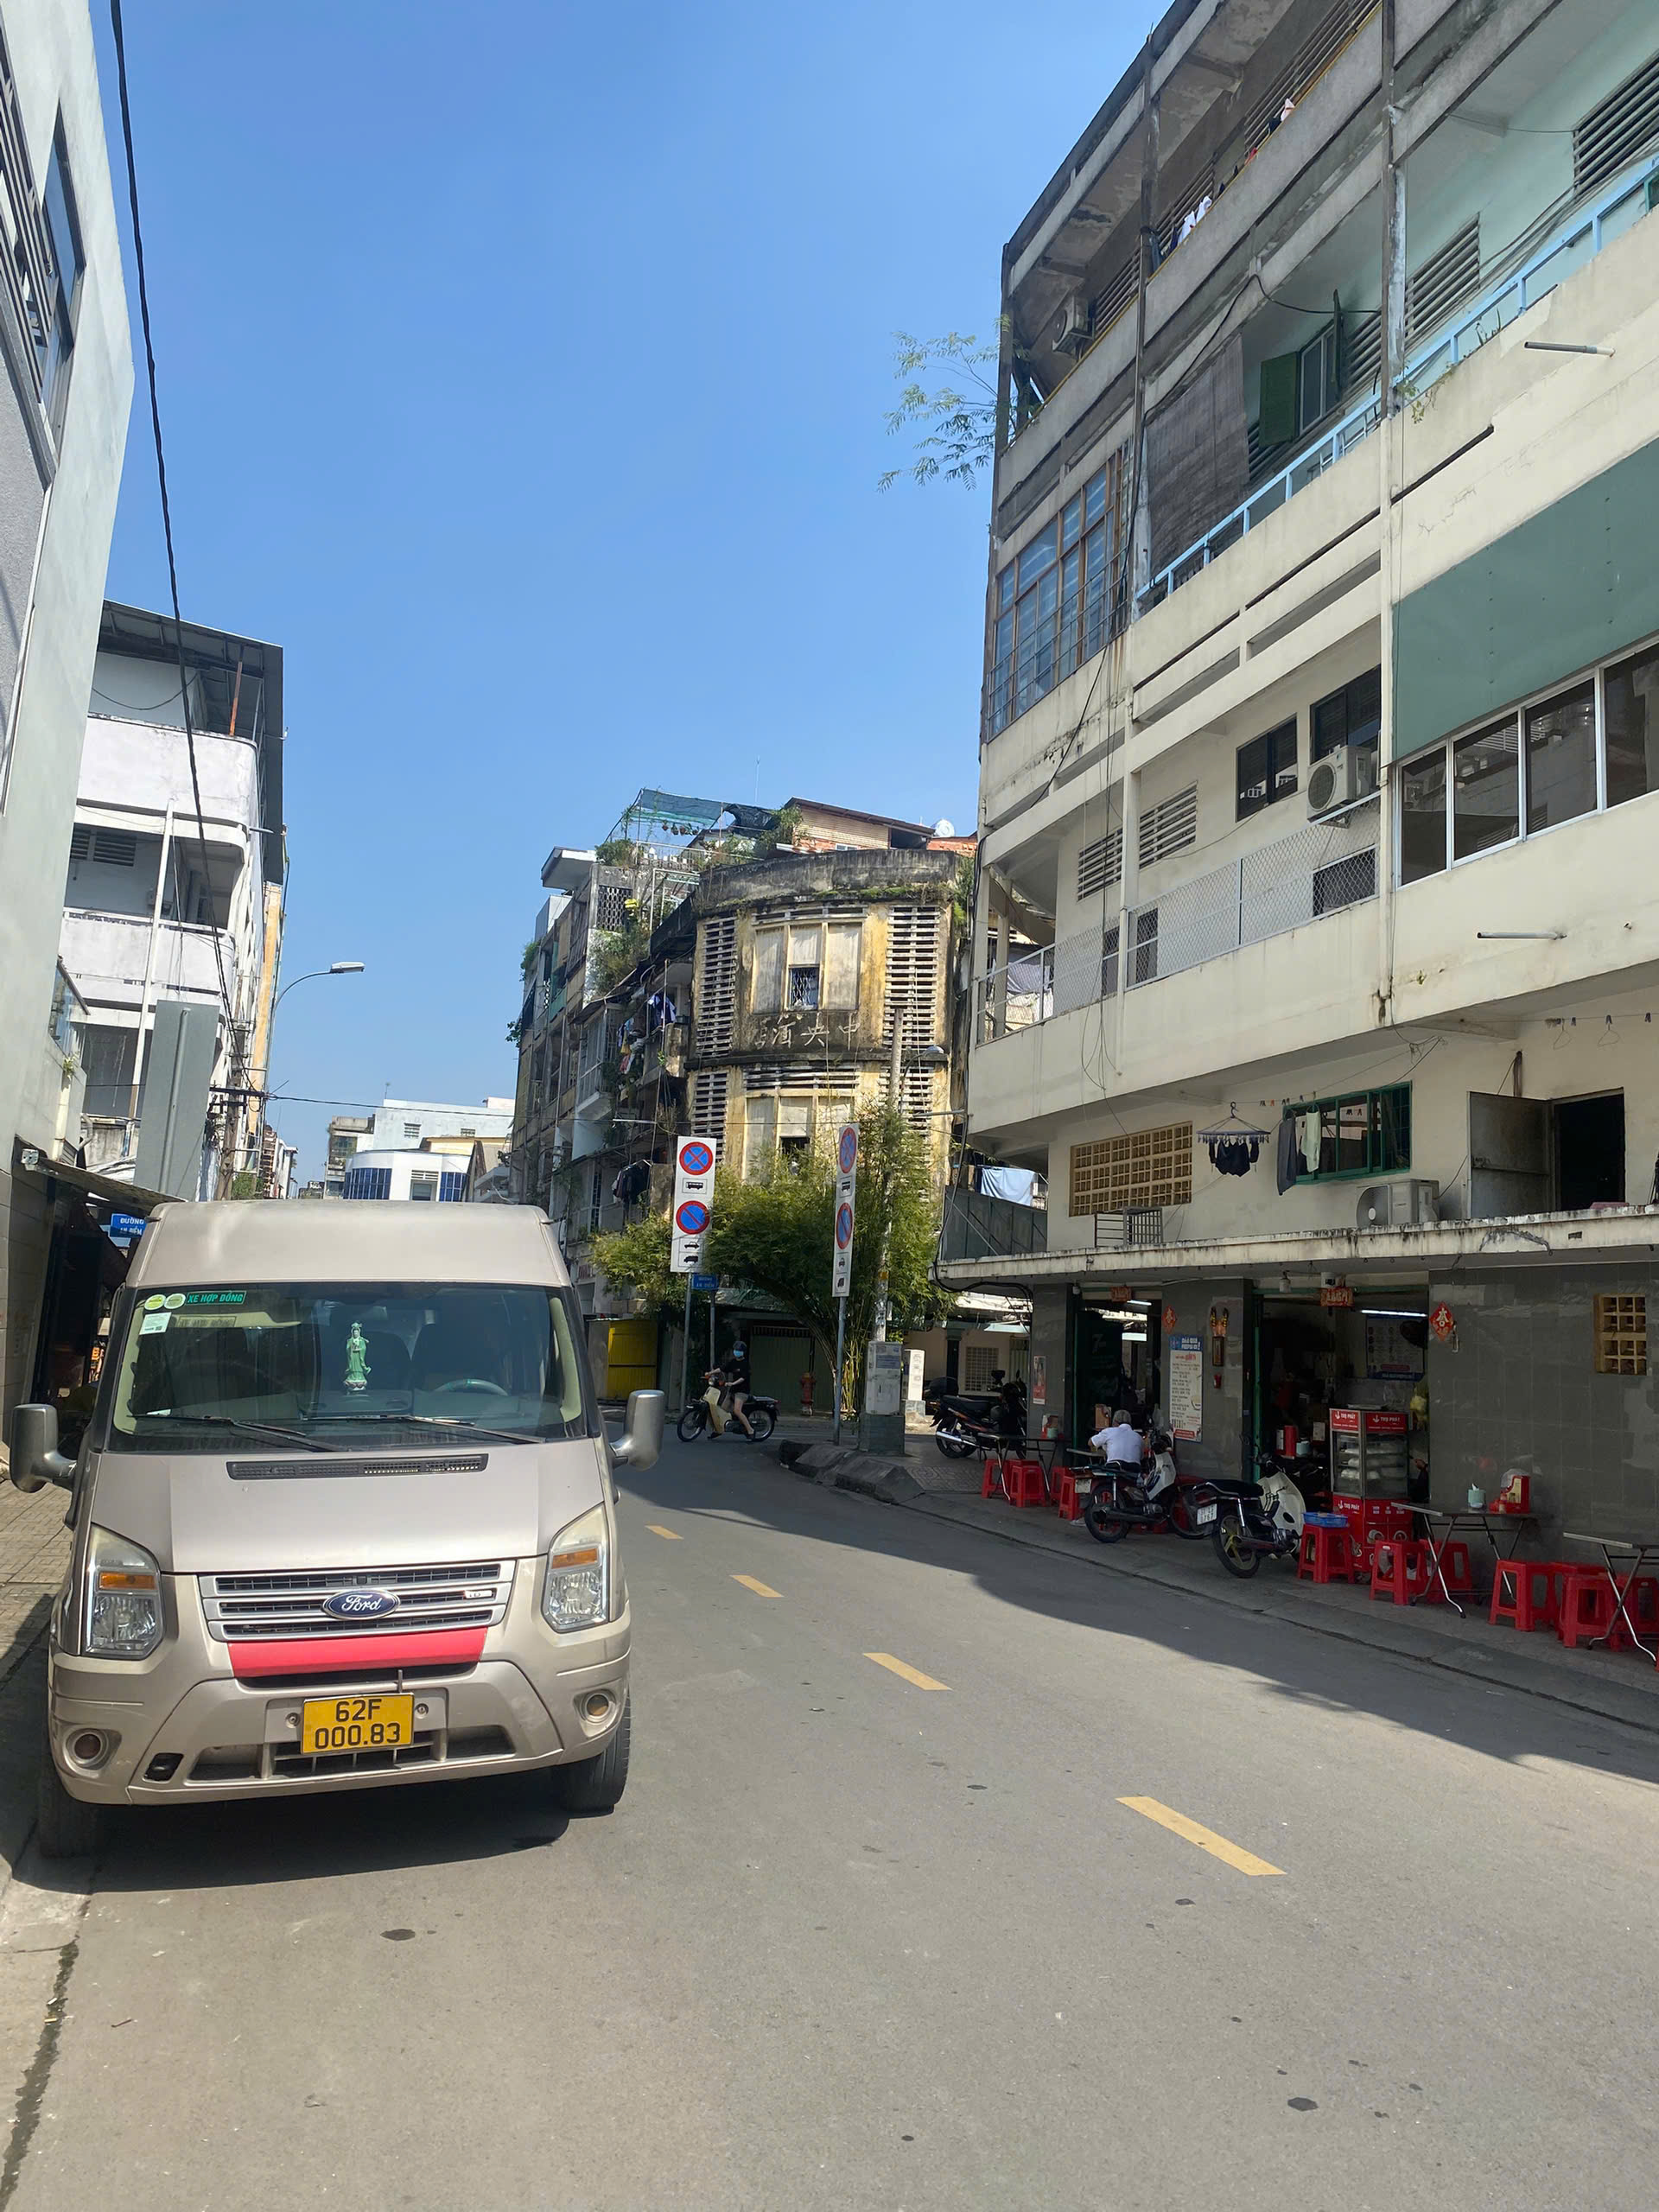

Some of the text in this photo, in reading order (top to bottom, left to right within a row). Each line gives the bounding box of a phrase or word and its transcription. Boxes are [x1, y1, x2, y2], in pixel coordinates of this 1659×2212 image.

[188, 1294, 199, 1303] XE
[200, 1294, 218, 1304] HỢP
[341, 1594, 382, 1611] Ford
[335, 1699, 382, 1722] 62F
[315, 1722, 400, 1749] 000.83
